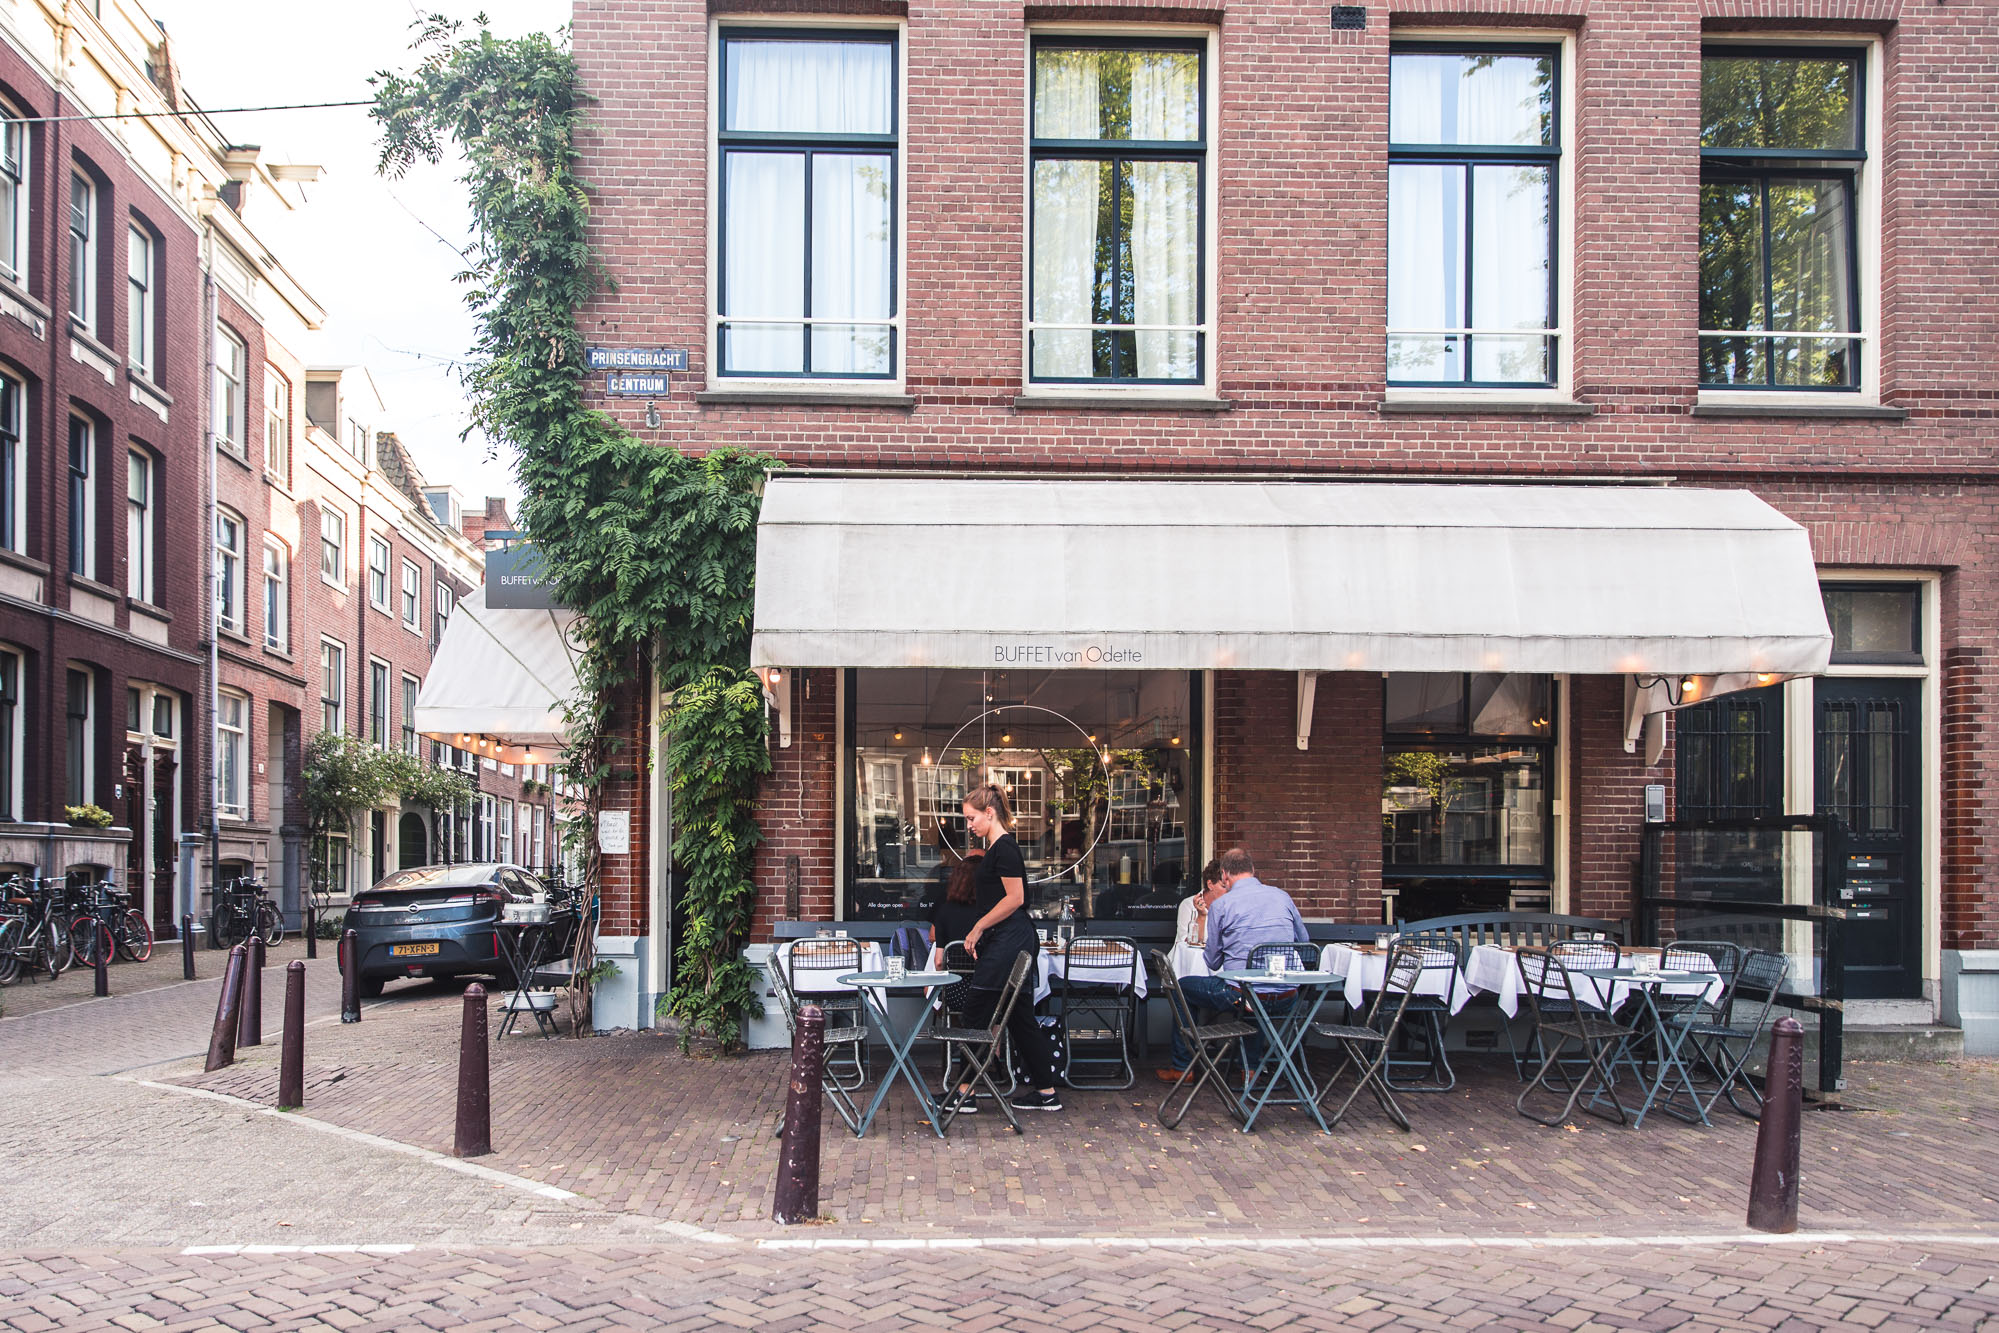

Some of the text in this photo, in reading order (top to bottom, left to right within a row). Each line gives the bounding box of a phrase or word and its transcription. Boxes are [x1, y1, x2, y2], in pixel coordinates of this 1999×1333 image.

[591, 352, 680, 366] PRINSENGRACHT
[611, 378, 664, 391] CENTRUM
[501, 575, 532, 585] BUFFET
[994, 645, 1142, 663] BUFFET van Odette
[398, 944, 435, 954] 71-XFN-3
